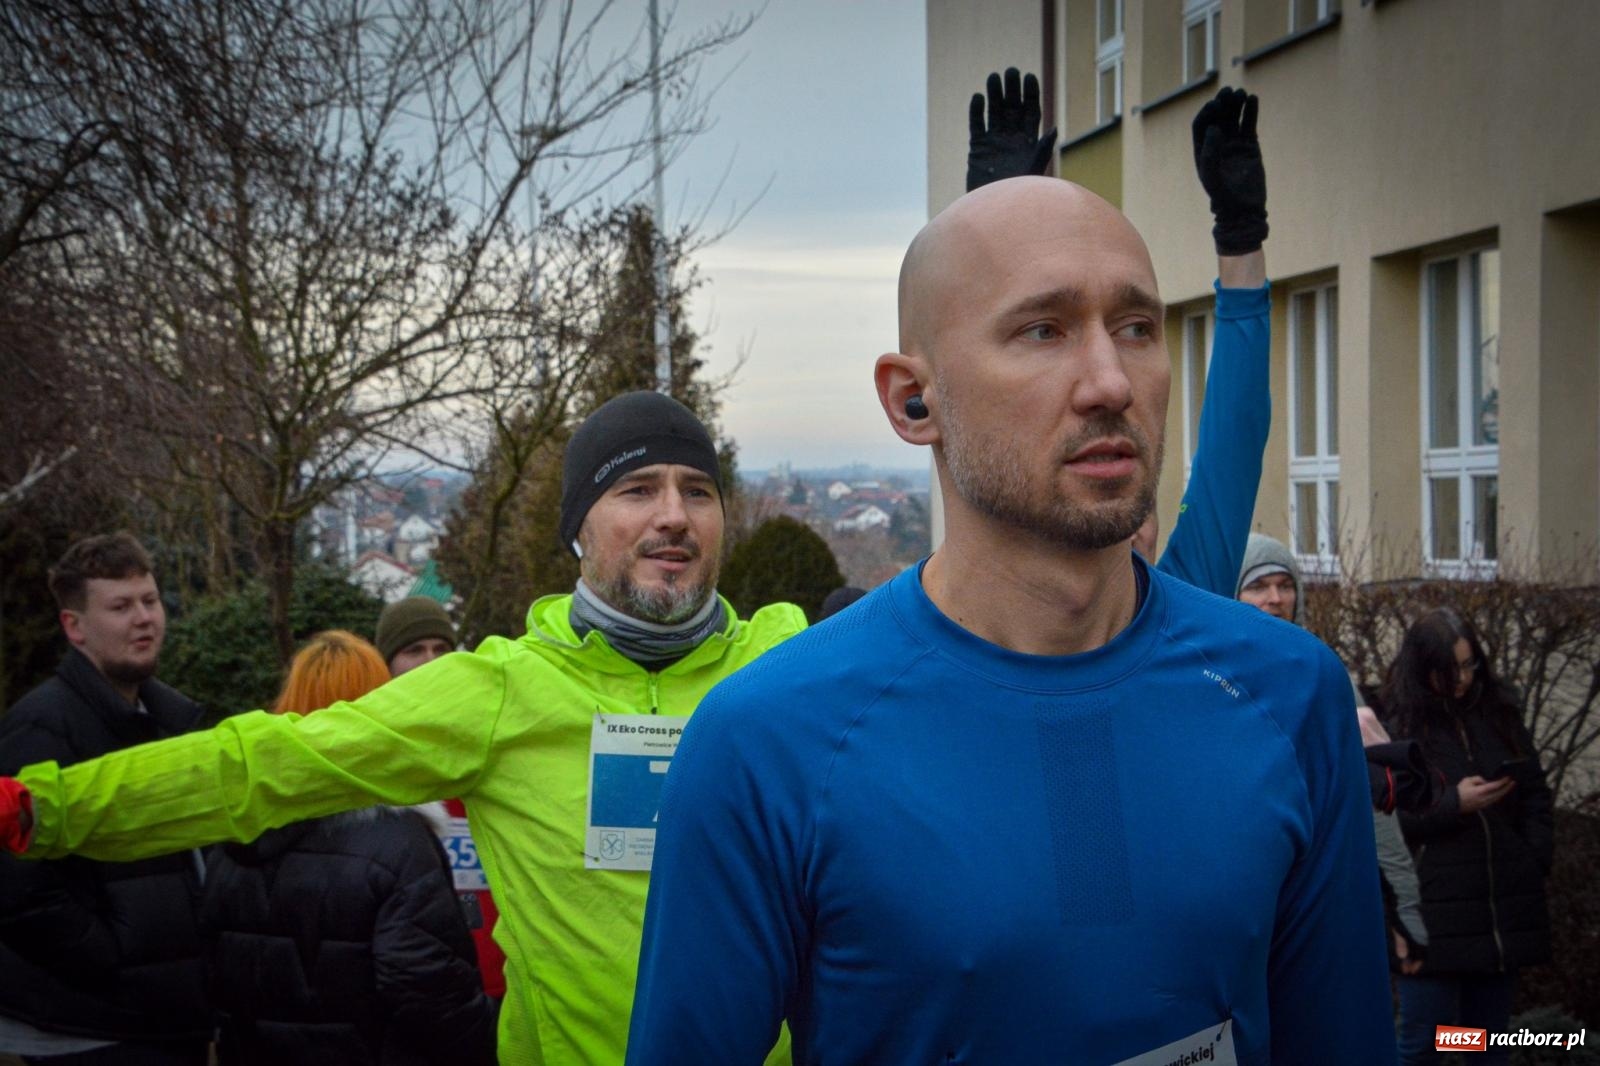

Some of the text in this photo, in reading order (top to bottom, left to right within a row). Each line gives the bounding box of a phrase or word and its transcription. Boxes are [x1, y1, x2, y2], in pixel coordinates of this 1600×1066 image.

[1203, 669, 1240, 698] KIPRUN
[607, 724, 682, 738] IX Eko Cross po
[1164, 1042, 1215, 1066] wickiej
